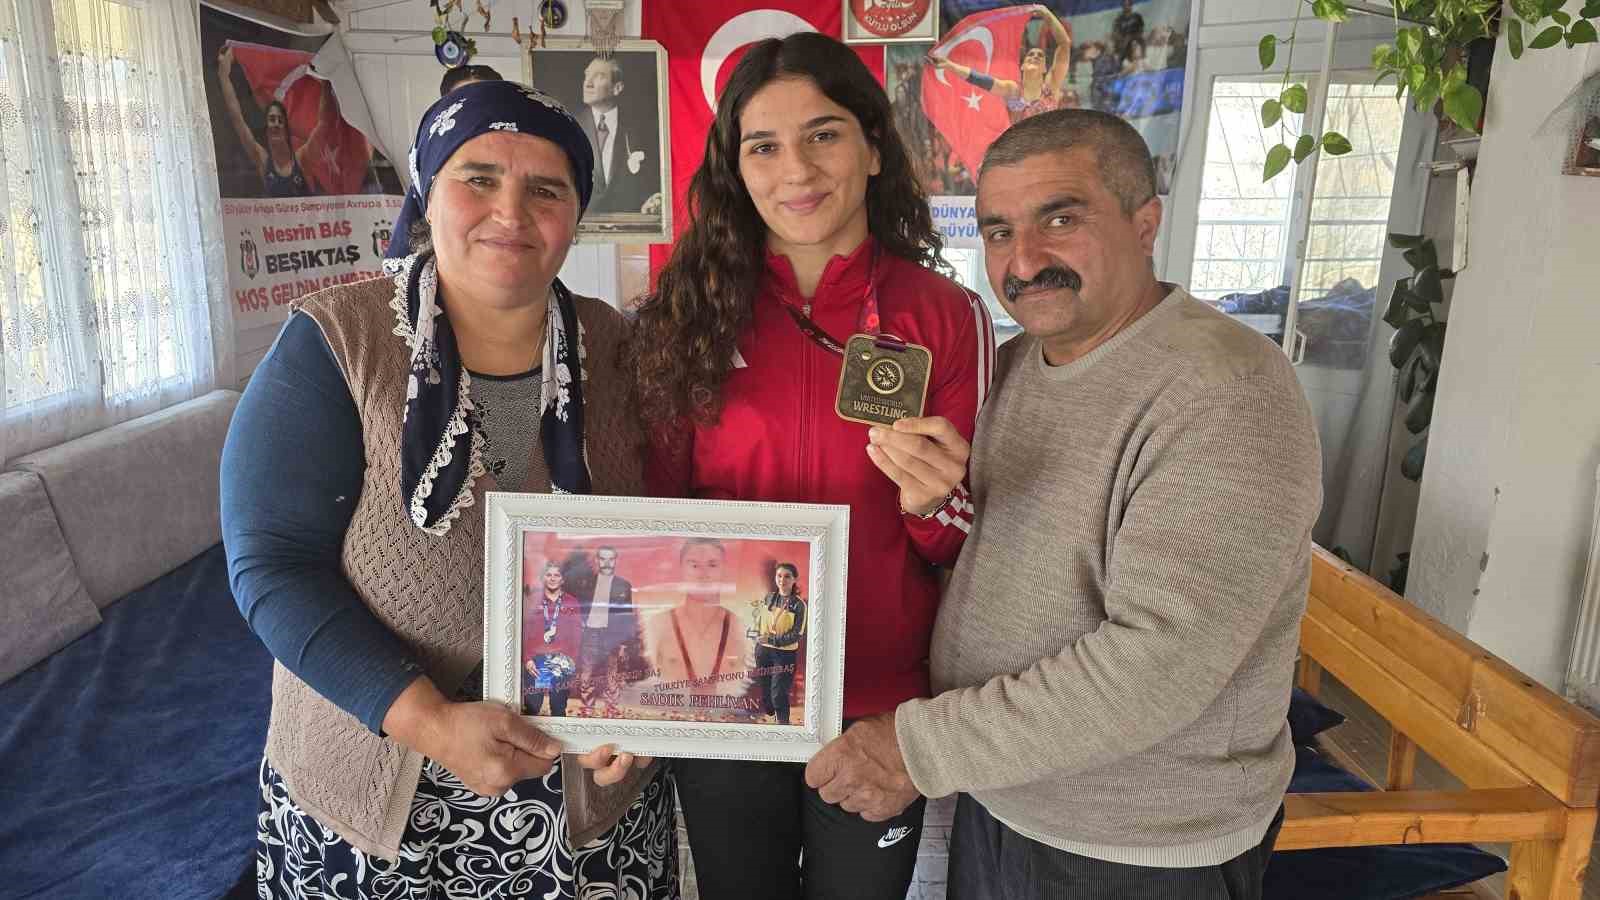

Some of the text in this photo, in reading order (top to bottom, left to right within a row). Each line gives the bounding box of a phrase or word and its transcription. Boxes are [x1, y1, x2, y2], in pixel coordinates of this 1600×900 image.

[931, 203, 976, 219] DÜNYA
[262, 219, 353, 245] Nesrin BAŞ
[236, 286, 270, 313] HOŞ
[853, 400, 908, 419] WRESTLING
[640, 692, 684, 707] SADIK
[885, 826, 908, 840] NIKE
